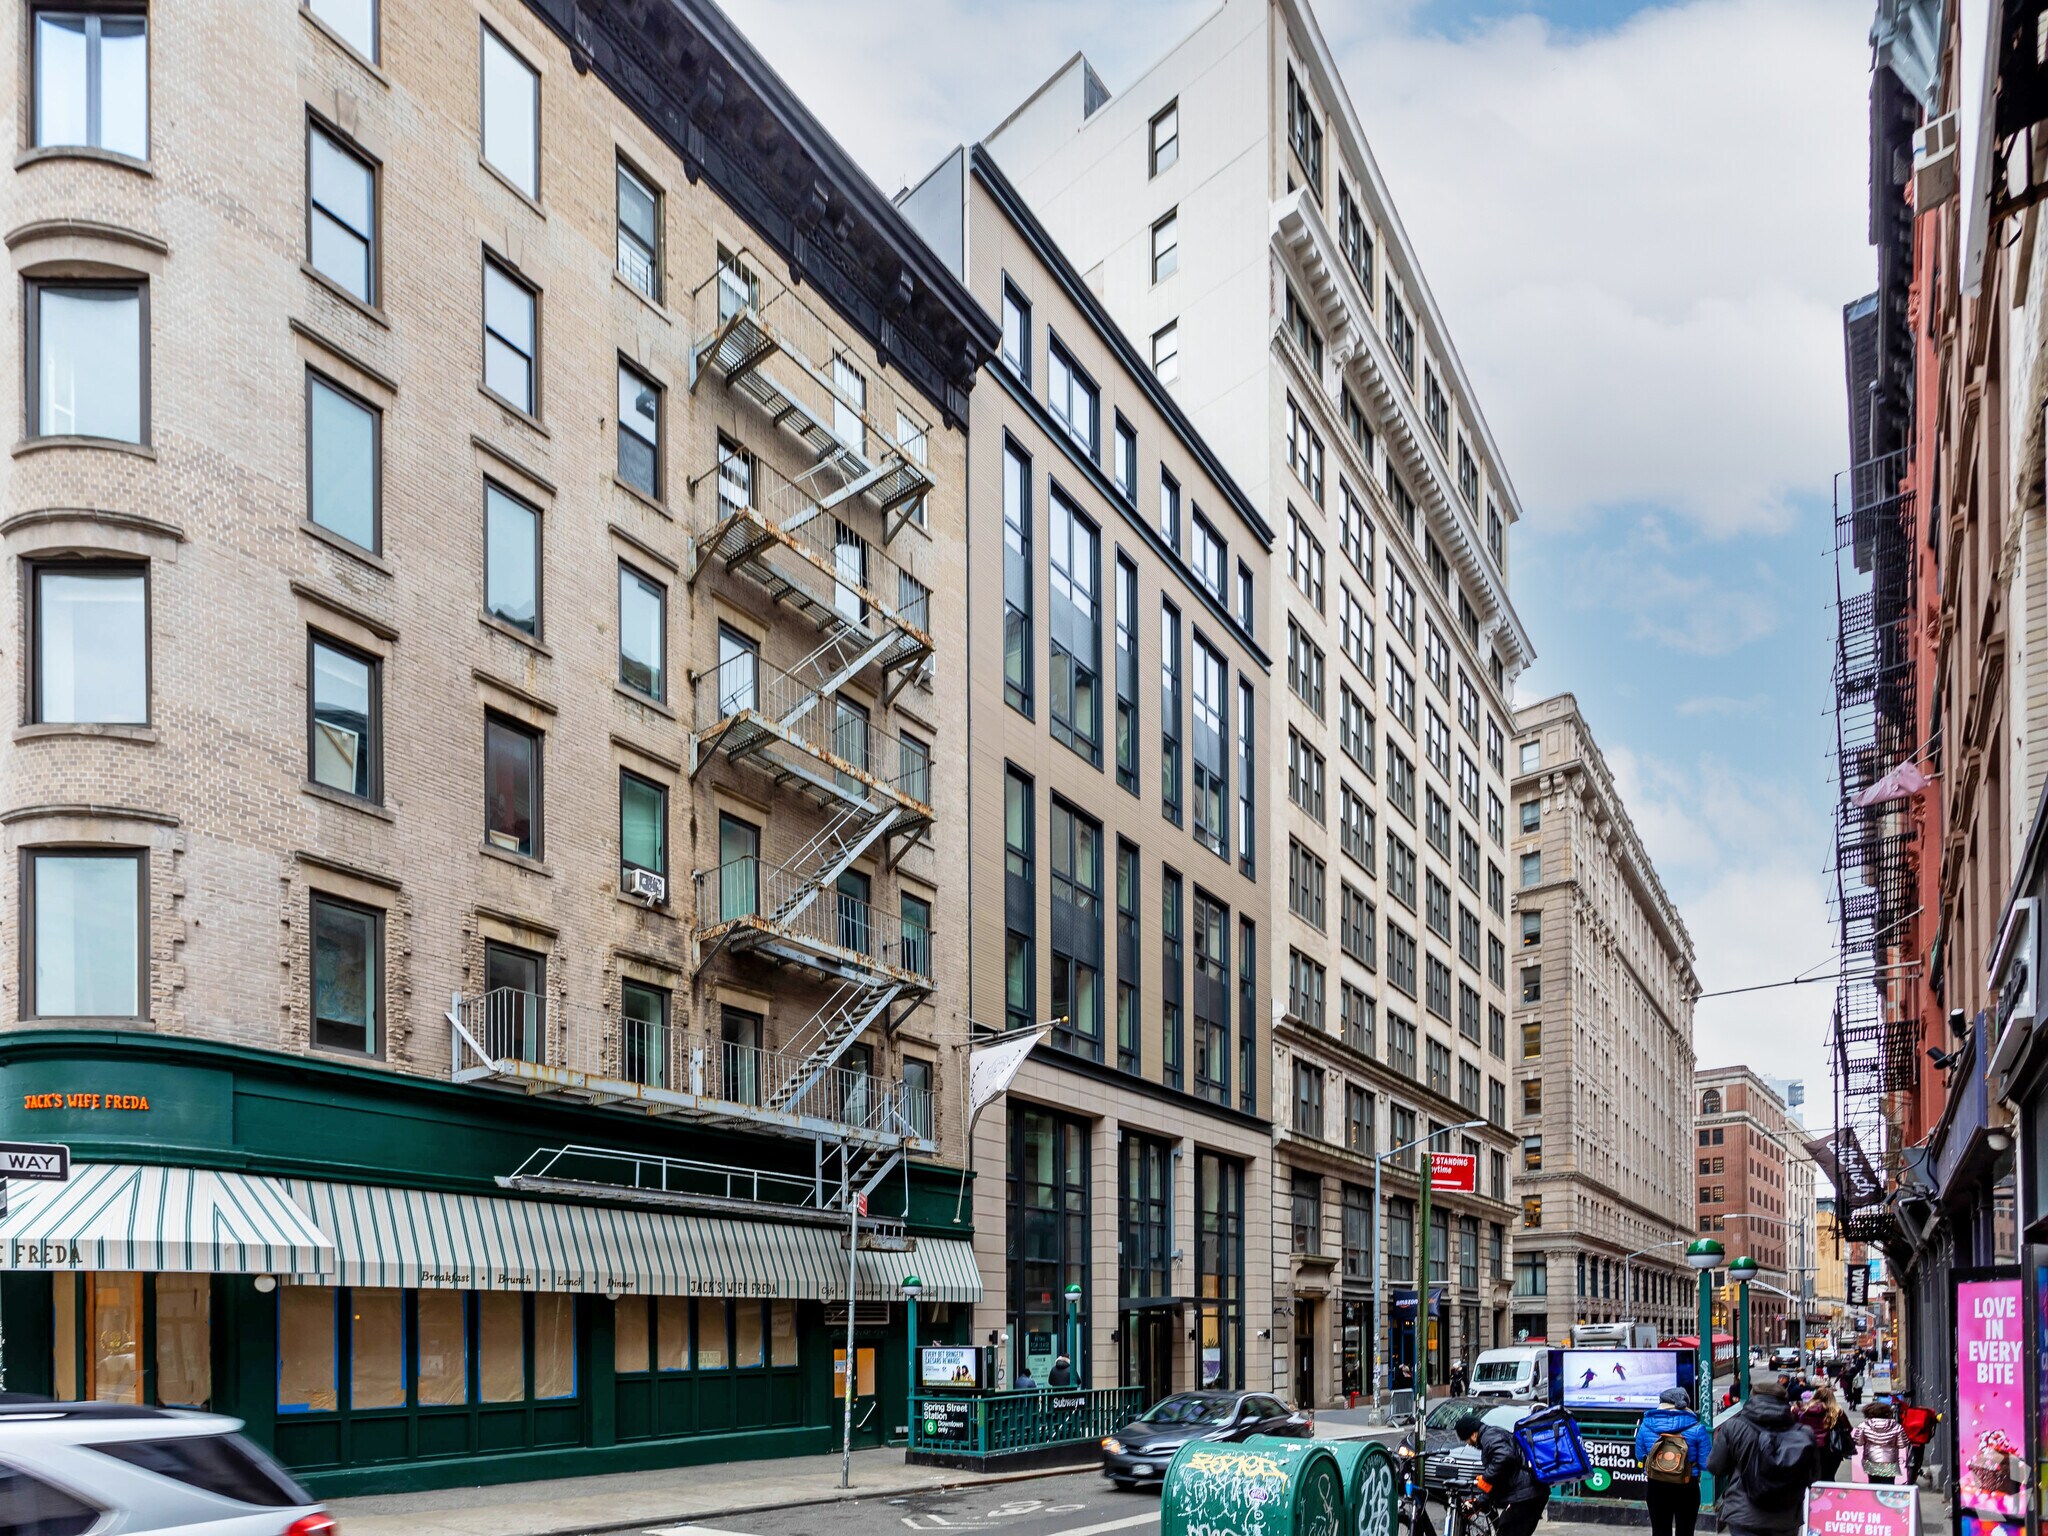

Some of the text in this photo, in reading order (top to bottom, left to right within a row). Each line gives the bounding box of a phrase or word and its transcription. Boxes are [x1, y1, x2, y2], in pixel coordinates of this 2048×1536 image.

[24, 1093, 150, 1110] JACK'S WIFE FREDA
[8, 1154, 54, 1170] WAY
[1432, 1165, 1452, 1175] ytime
[1436, 1157, 1468, 1167] STANDING
[16, 1245, 83, 1264] FREDA
[421, 1271, 635, 1289] Breakfast Brunch Lunch Dinner
[691, 1281, 777, 1295] JACK'S WIFE FREDA
[1851, 1268, 1865, 1304] MoMA
[1395, 1298, 1418, 1306] amazon
[1974, 1296, 2016, 1319] LOVE
[1986, 1319, 2004, 1340] IN
[1969, 1340, 2023, 1363] EVERY
[1977, 1362, 2015, 1385] BITE
[923, 1402, 968, 1413] Spring Street
[1053, 1397, 1079, 1410] Subway
[923, 1411, 948, 1420] Station
[927, 1420, 964, 1432] 6 Downtown
[1584, 1440, 1630, 1457] Spring
[1592, 1470, 1649, 1486] 6 Downto
[1835, 1510, 1881, 1524] LOVE IN
[1825, 1521, 1892, 1536] EVERY BITE
